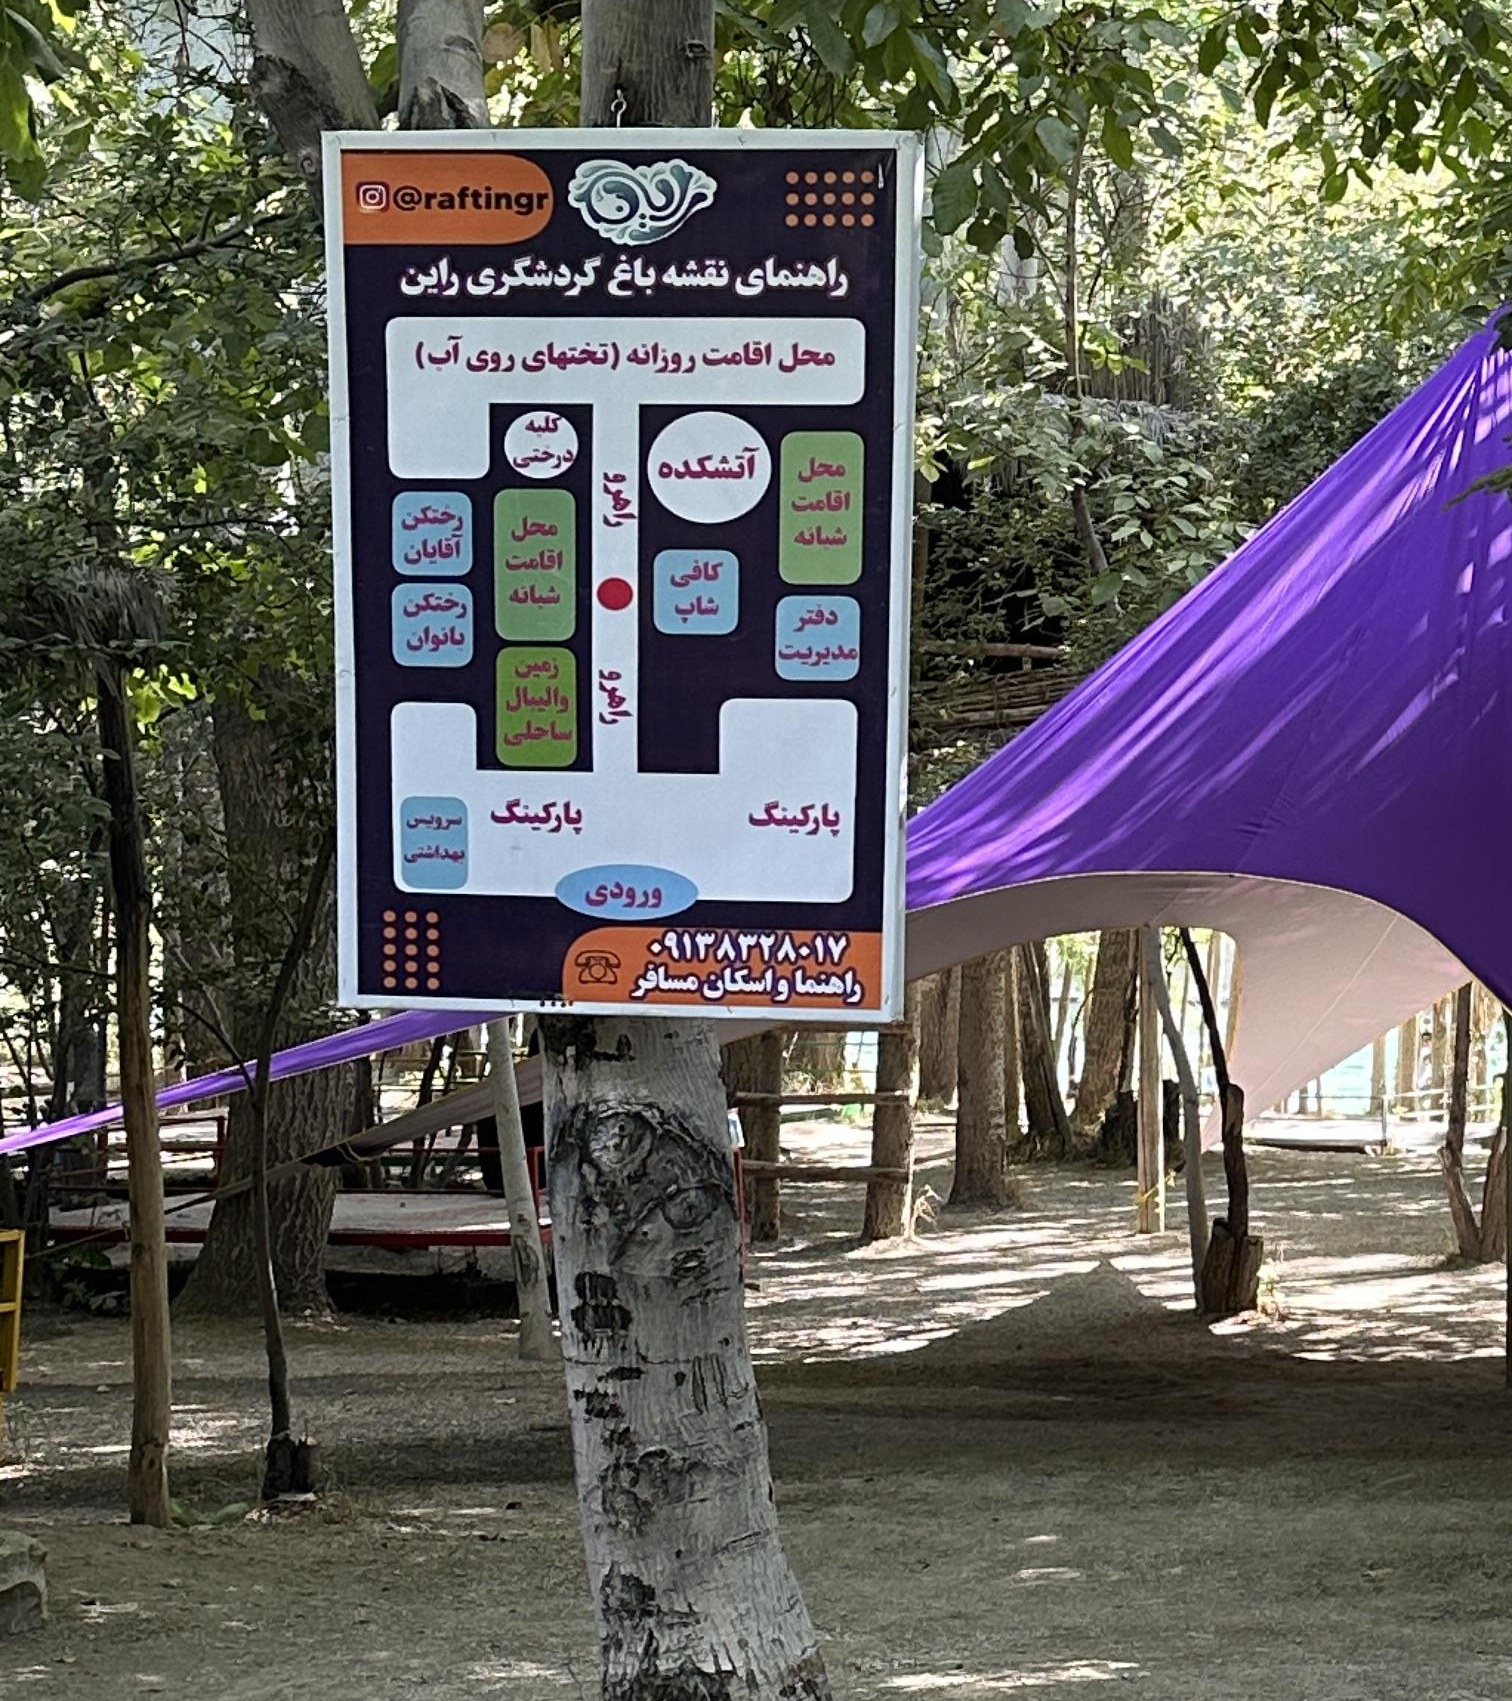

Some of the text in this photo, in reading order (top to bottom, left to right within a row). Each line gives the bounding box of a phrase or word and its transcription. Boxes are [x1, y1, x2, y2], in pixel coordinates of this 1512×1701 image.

[393, 186, 549, 216] @raftingr
[401, 253, 848, 296] راهنمای نقشه باغ گردشگری راین
[415, 335, 836, 373] محل اقامت روزانه (تختهای روی آب)
[525, 416, 561, 437] کلبه
[513, 445, 574, 468] درختی
[658, 447, 760, 480] آتشکده
[798, 457, 846, 483] محل
[603, 472, 637, 527] راهرو
[791, 489, 850, 512] اقامت
[402, 504, 463, 531] رختکن
[511, 515, 558, 542] محل
[404, 533, 463, 564] آقایان
[794, 525, 847, 550] شبانه
[505, 549, 563, 571] اقامت
[670, 559, 723, 587] کافی
[403, 592, 467, 619] رختکن
[509, 584, 560, 609] شبانه
[675, 596, 719, 624] شاپ
[793, 604, 838, 632] دفتر
[406, 625, 465, 652] بانوان
[514, 657, 560, 680] زمین
[778, 644, 858, 667] مدیریت
[506, 685, 569, 713] والیبال
[599, 669, 633, 725] راهرو
[503, 719, 572, 746] ساحلی
[406, 814, 462, 831] سرویس
[490, 798, 582, 835] پارکینگ
[748, 801, 841, 837] پارکینگ
[404, 844, 465, 864] بهداشتی
[585, 881, 662, 908] ورودی
[631, 965, 698, 997] مسافر
[702, 965, 773, 998] اسکان
[795, 969, 862, 1003] راهنما
